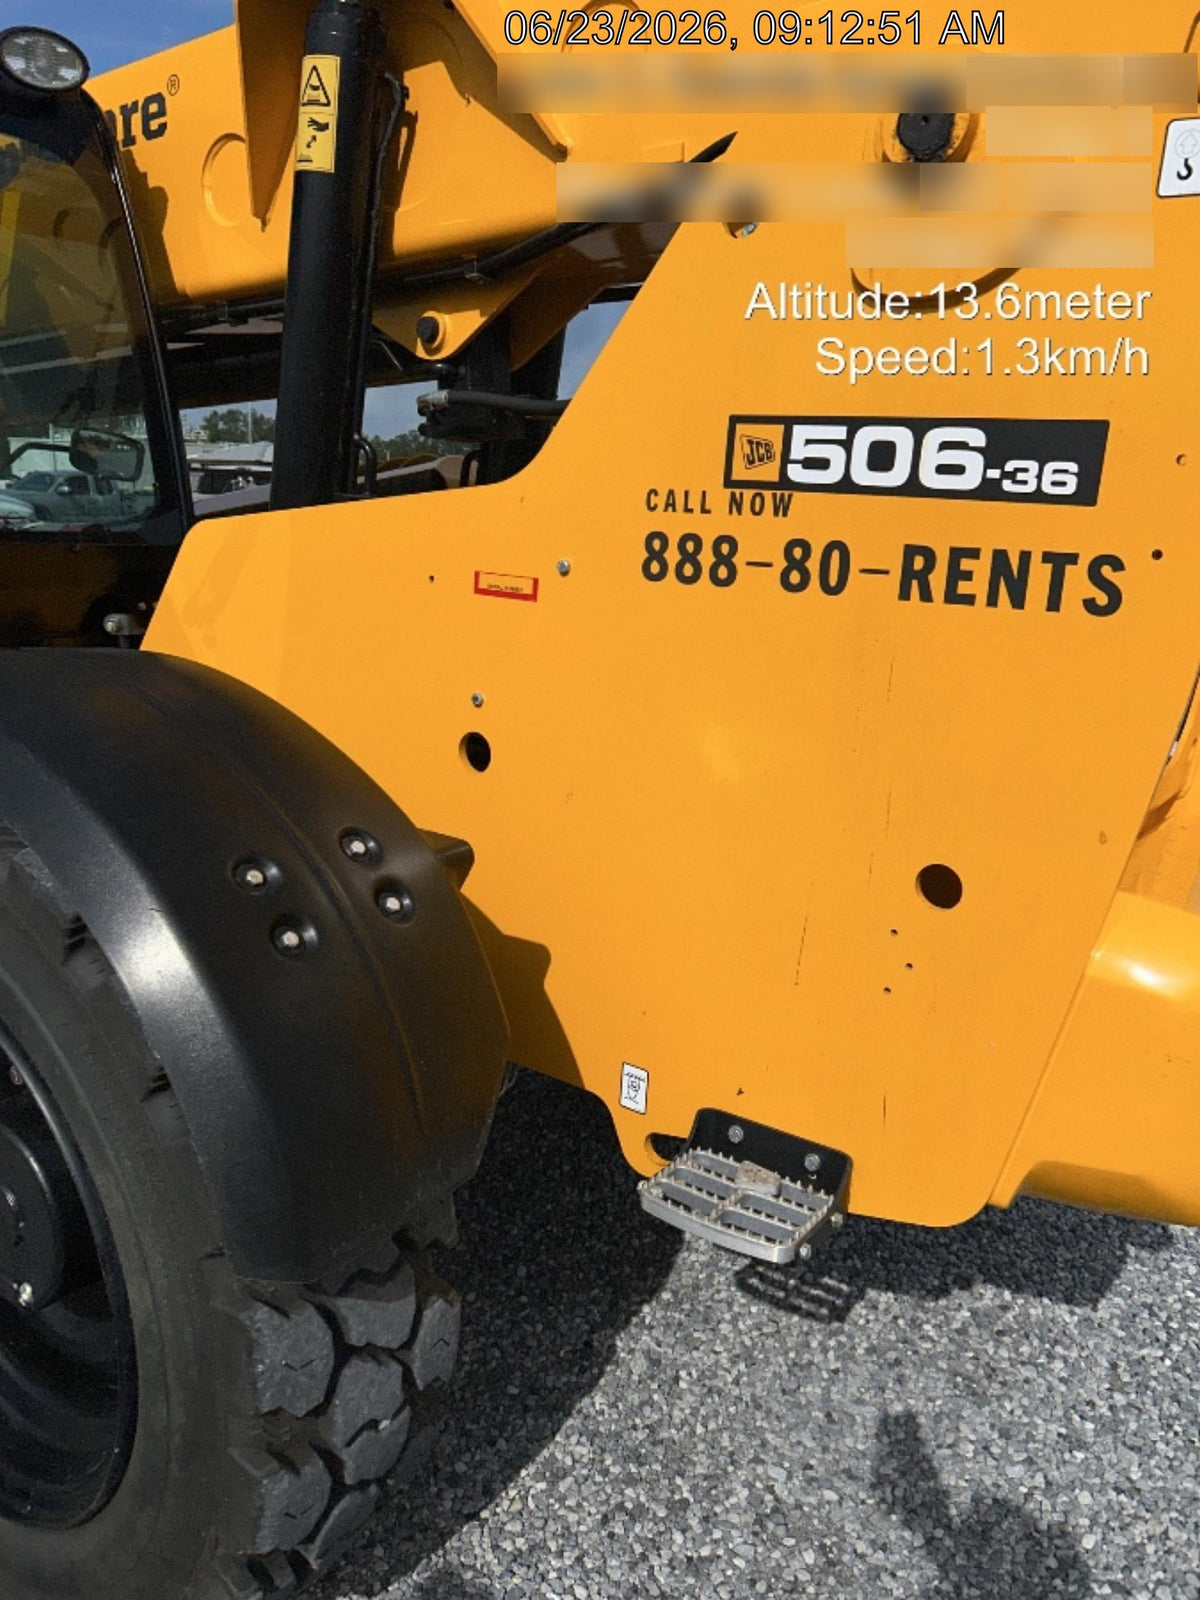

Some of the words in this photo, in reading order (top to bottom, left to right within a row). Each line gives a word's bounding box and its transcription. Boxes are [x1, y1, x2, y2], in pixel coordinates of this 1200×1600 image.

[744, 437, 774, 467] JCB
[786, 424, 1079, 495] 506-36
[645, 488, 713, 515] CALL
[728, 491, 794, 518] NOW
[641, 530, 1126, 617] 888-80-RENTS
